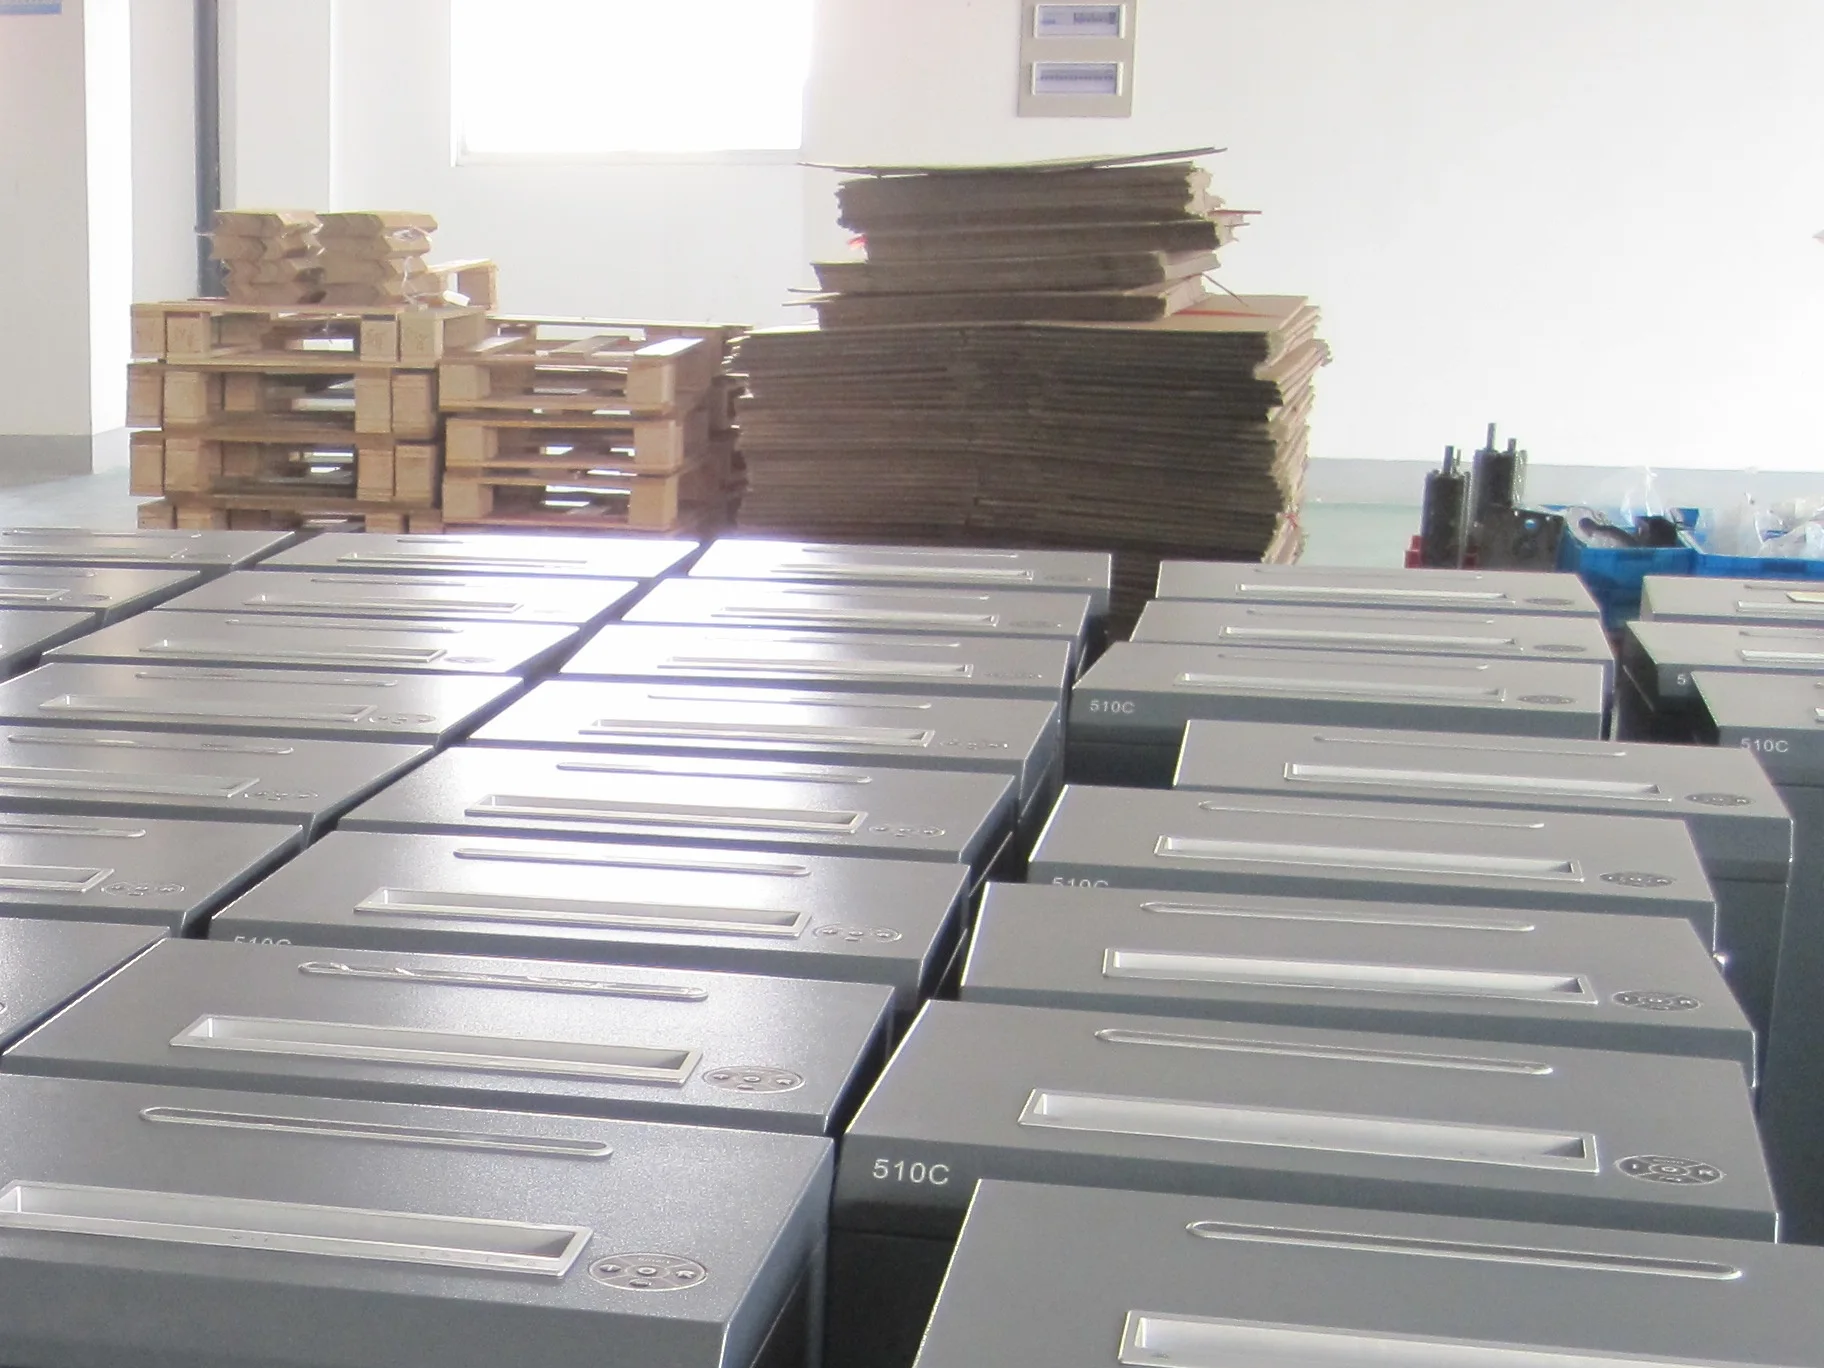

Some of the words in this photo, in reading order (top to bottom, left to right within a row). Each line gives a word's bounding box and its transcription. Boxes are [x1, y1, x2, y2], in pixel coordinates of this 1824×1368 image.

[1090, 700, 1136, 714] 510C
[1741, 738, 1790, 753] 510C
[872, 1158, 950, 1185] 510C
